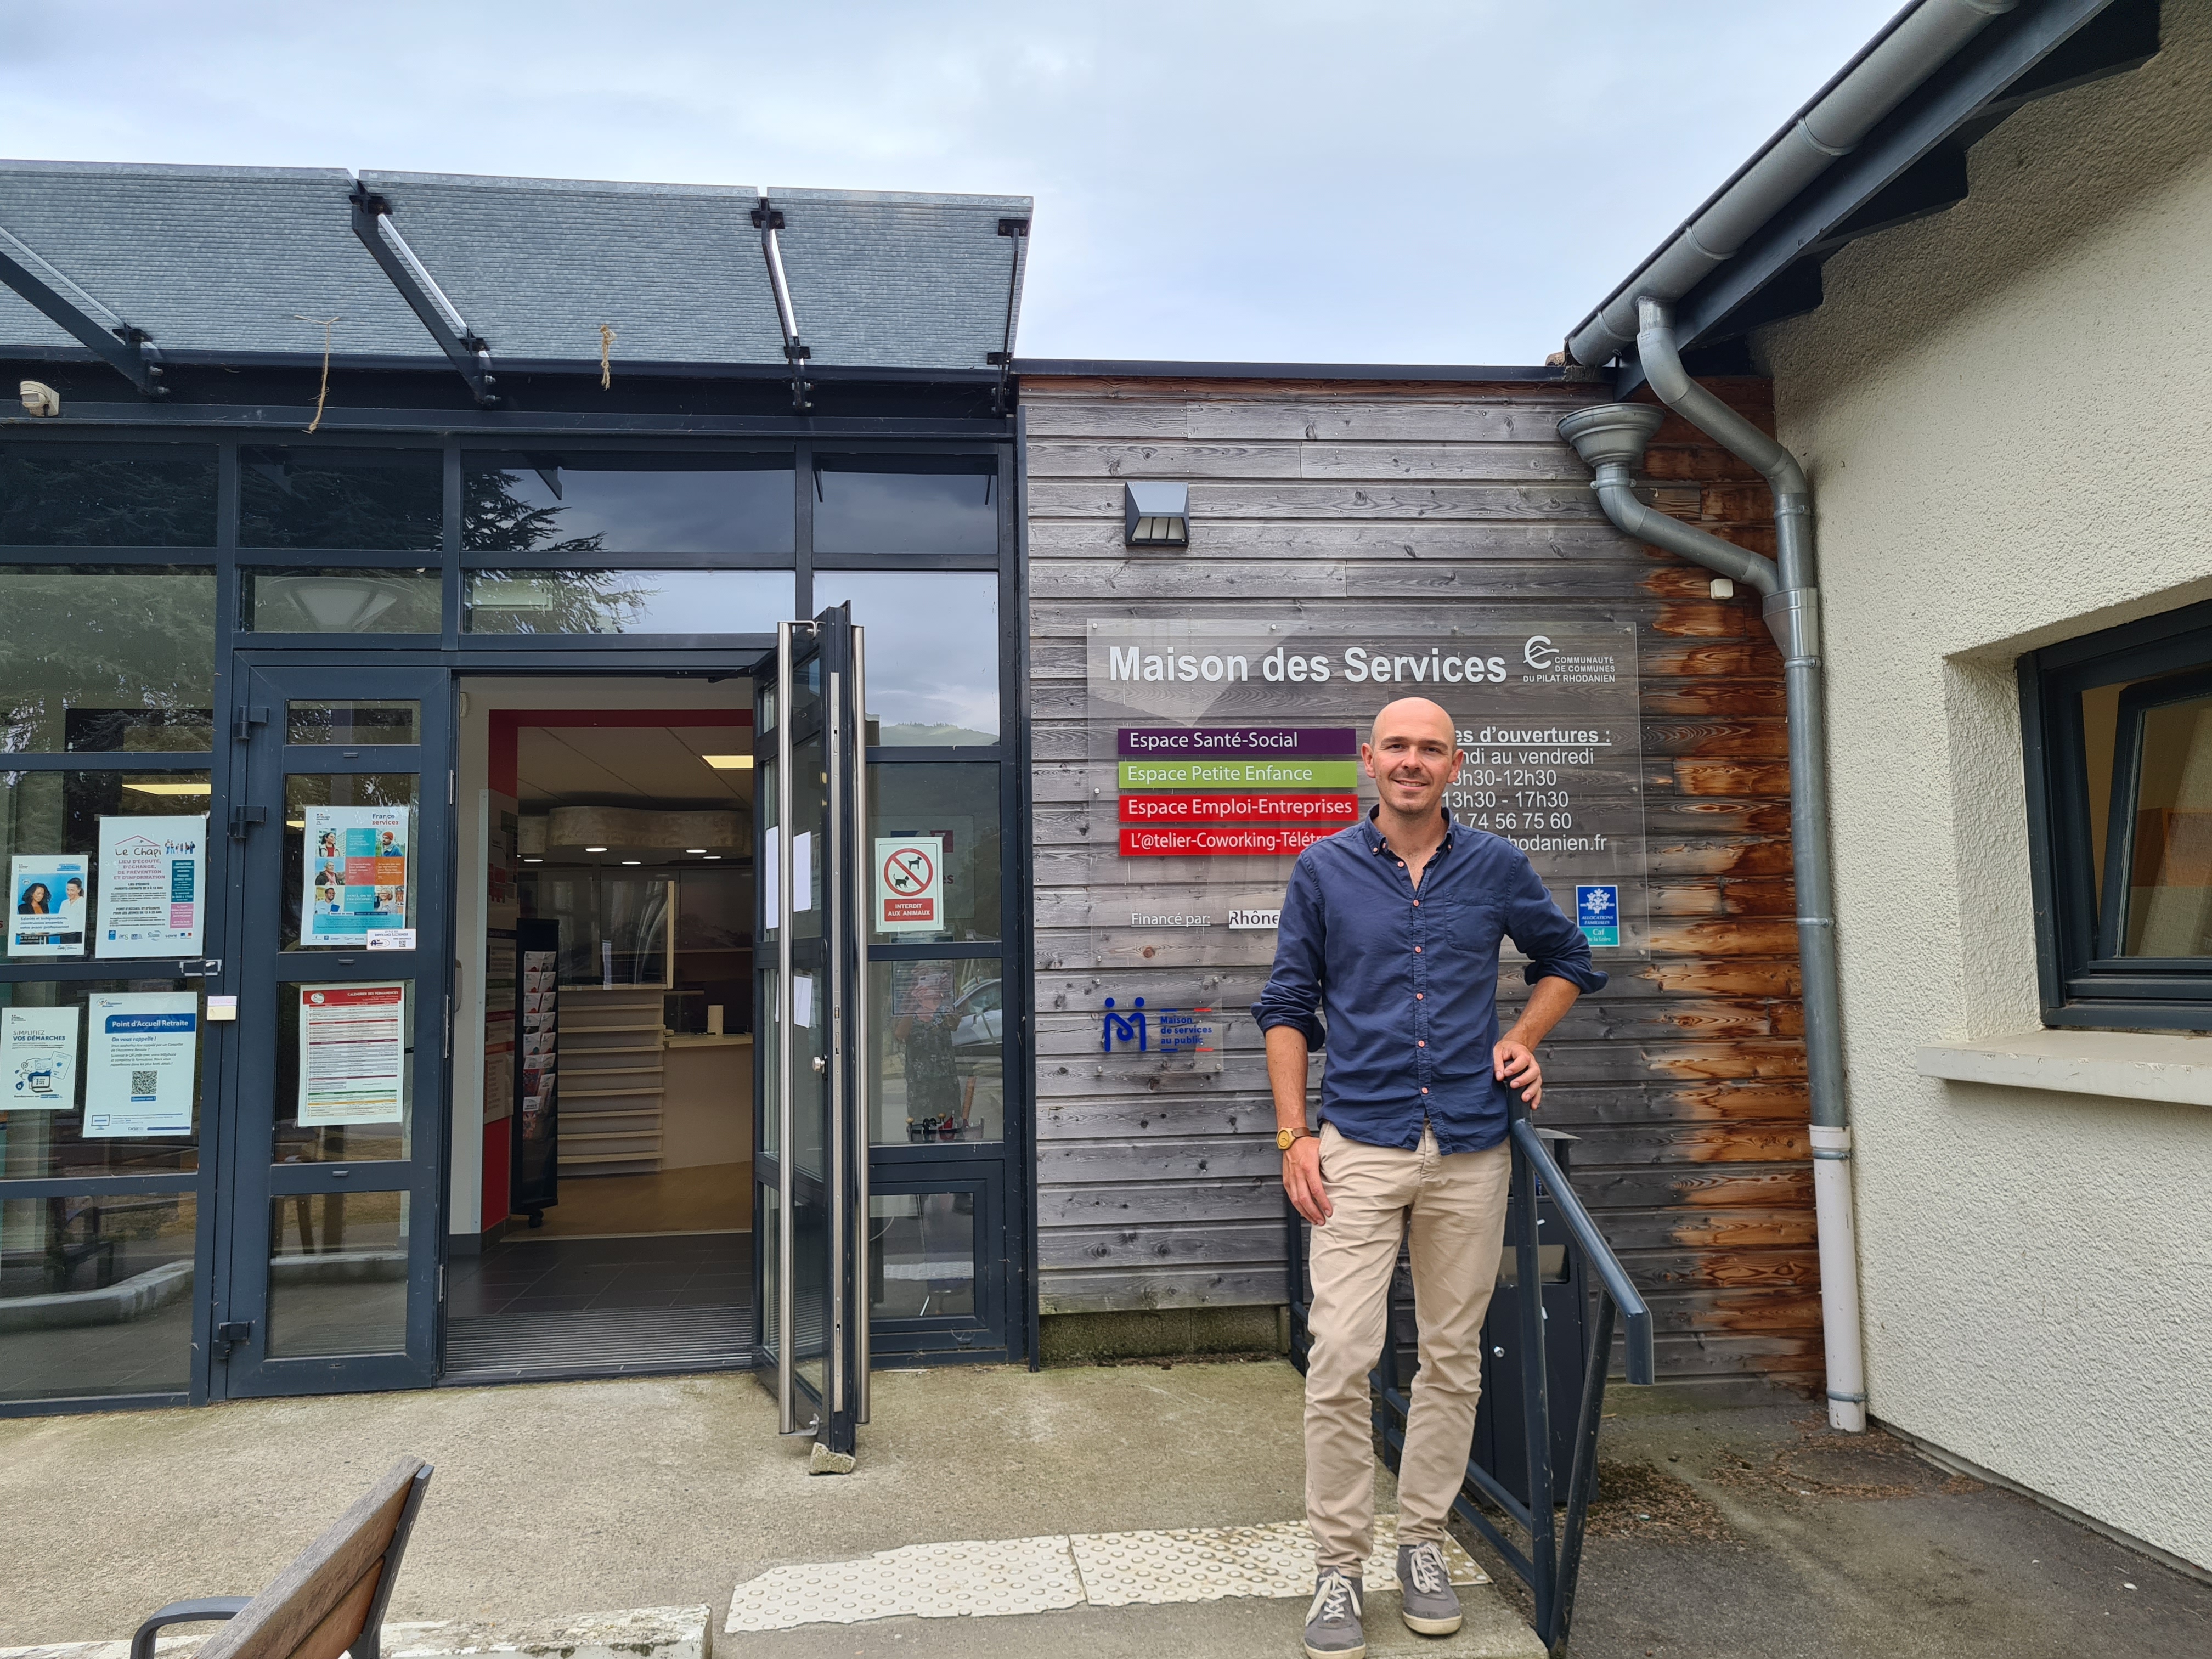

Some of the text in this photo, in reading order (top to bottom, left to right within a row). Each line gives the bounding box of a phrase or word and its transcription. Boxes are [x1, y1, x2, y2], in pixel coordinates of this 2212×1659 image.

[1109, 646, 1507, 683] Maison des Services
[1130, 731, 1298, 751] Espace Santé-Social
[1480, 726, 1599, 743] d'ouvertures
[1491, 752, 1512, 764] au
[1519, 748, 1594, 764] vendredi
[1128, 765, 1312, 784] Espace Petite Enfance
[1128, 798, 1352, 818] Espace Emploi-Entreprises
[1442, 791, 1496, 808] 13h30
[1515, 791, 1568, 808] 17h30
[1467, 813, 1489, 829] 74
[1495, 813, 1516, 829] 56
[1523, 812, 1544, 829] 75
[1550, 812, 1572, 829] 60
[1131, 832, 1328, 850] L'@telier-Coworking-Télétr
[134, 847, 161, 857] Chapi
[1131, 913, 1211, 927] Financé par:
[1160, 1015, 1192, 1024] Maison
[1160, 1025, 1212, 1034] de services
[1175, 1036, 1203, 1046] public
